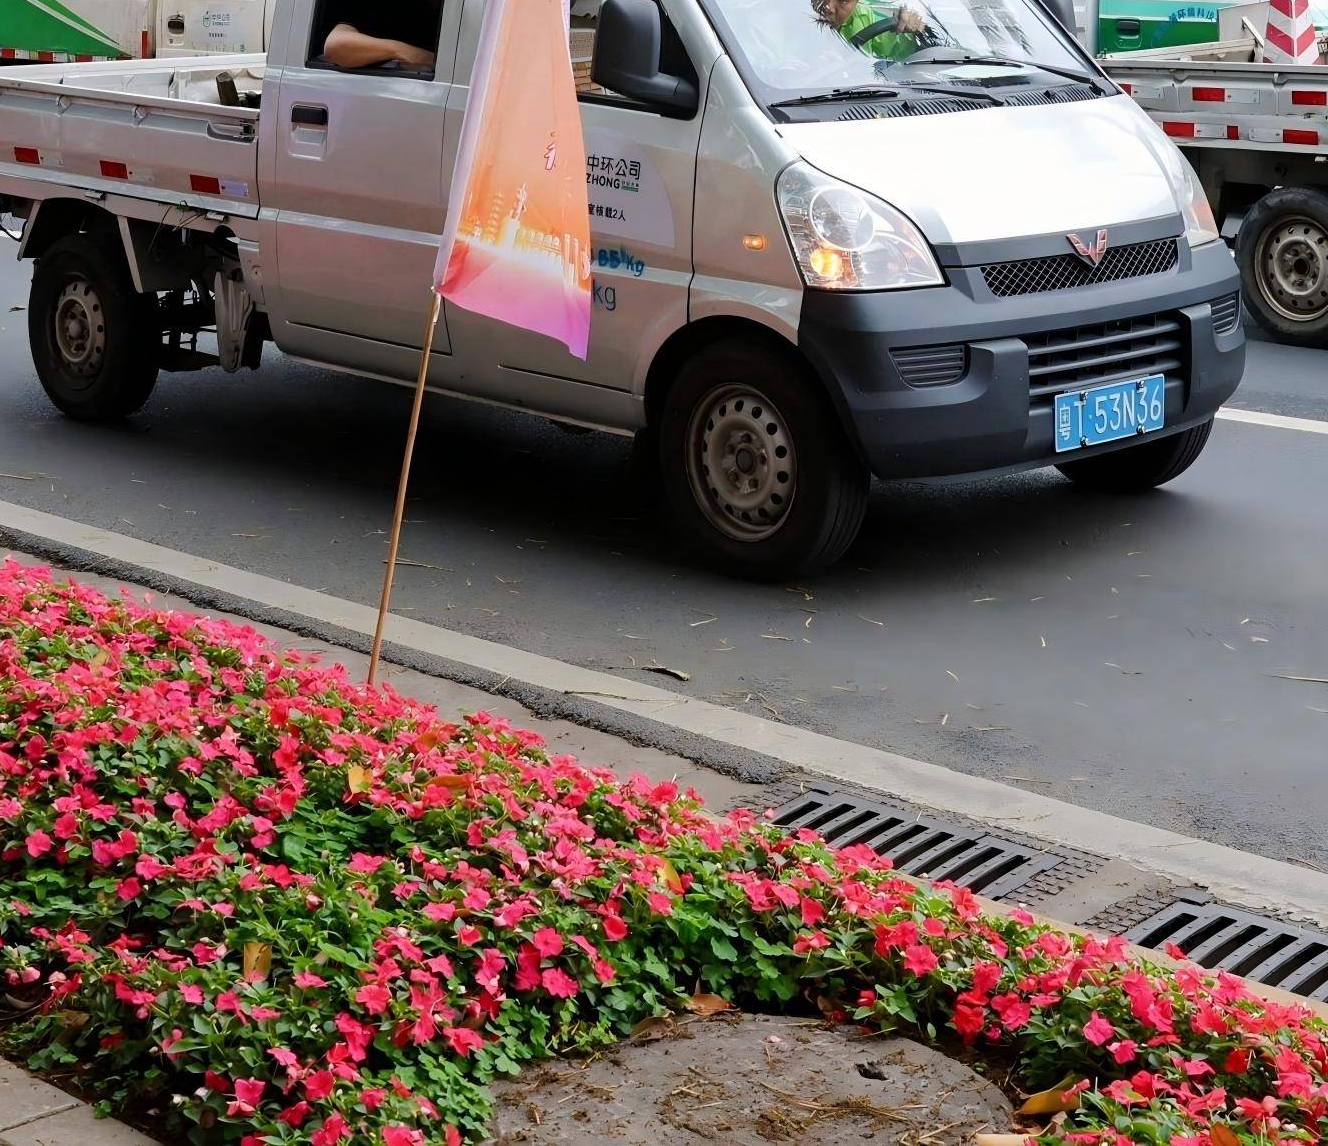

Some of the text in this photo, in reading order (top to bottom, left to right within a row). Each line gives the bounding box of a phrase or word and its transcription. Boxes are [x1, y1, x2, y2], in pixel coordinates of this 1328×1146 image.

[587, 153, 641, 180] 中环公司
[586, 173, 620, 189] ZHONG
